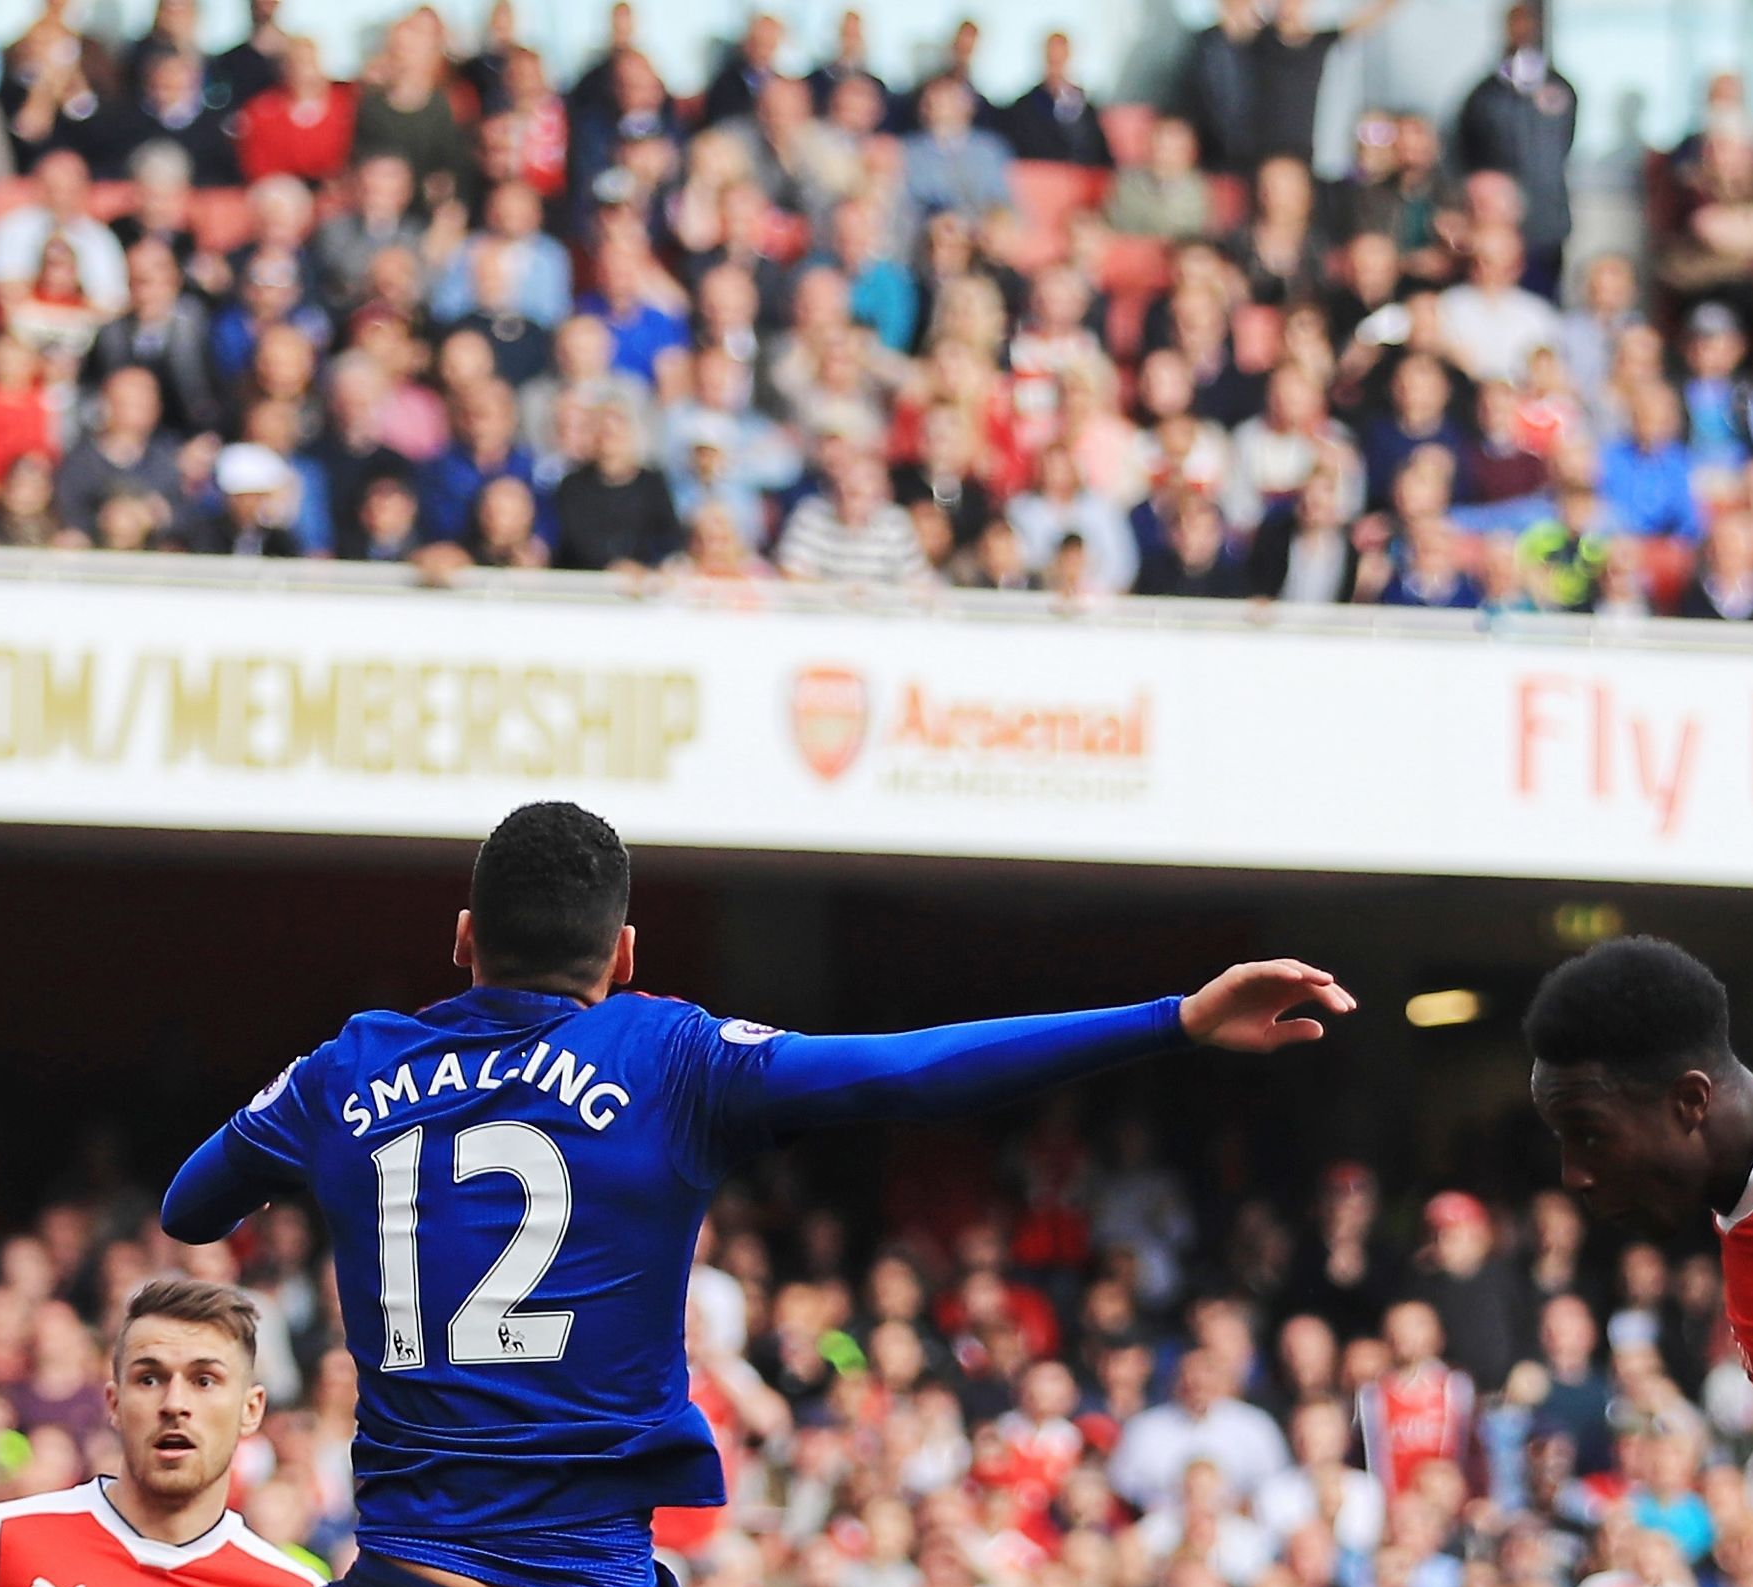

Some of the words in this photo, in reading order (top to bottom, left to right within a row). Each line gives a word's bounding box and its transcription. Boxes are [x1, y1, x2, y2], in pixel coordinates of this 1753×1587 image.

[887, 682, 1151, 759] Arsenal
[1512, 673, 1702, 838] Fly
[342, 1040, 631, 1138] SMALING
[371, 1120, 575, 1373] 12
